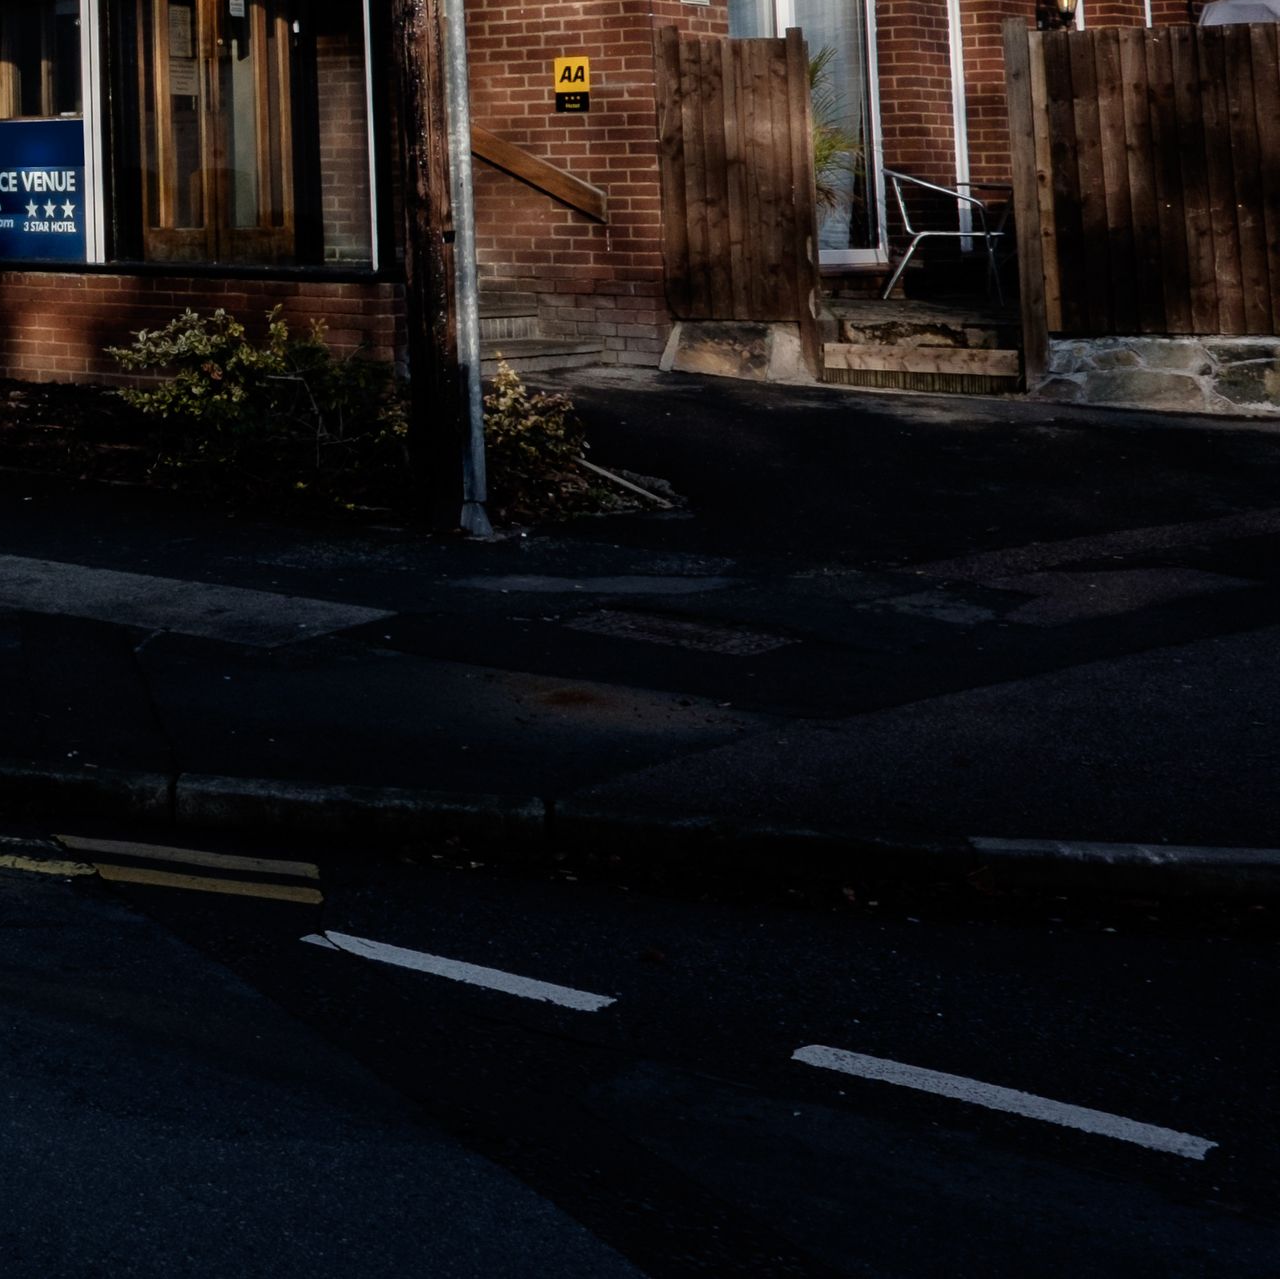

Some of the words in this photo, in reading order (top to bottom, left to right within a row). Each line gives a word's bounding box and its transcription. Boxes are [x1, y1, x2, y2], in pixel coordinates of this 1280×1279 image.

[559, 65, 585, 83] AA
[21, 171, 76, 192] VENUE
[23, 221, 30, 232] 3
[30, 221, 50, 232] STAR
[51, 221, 77, 232] HOTEL
